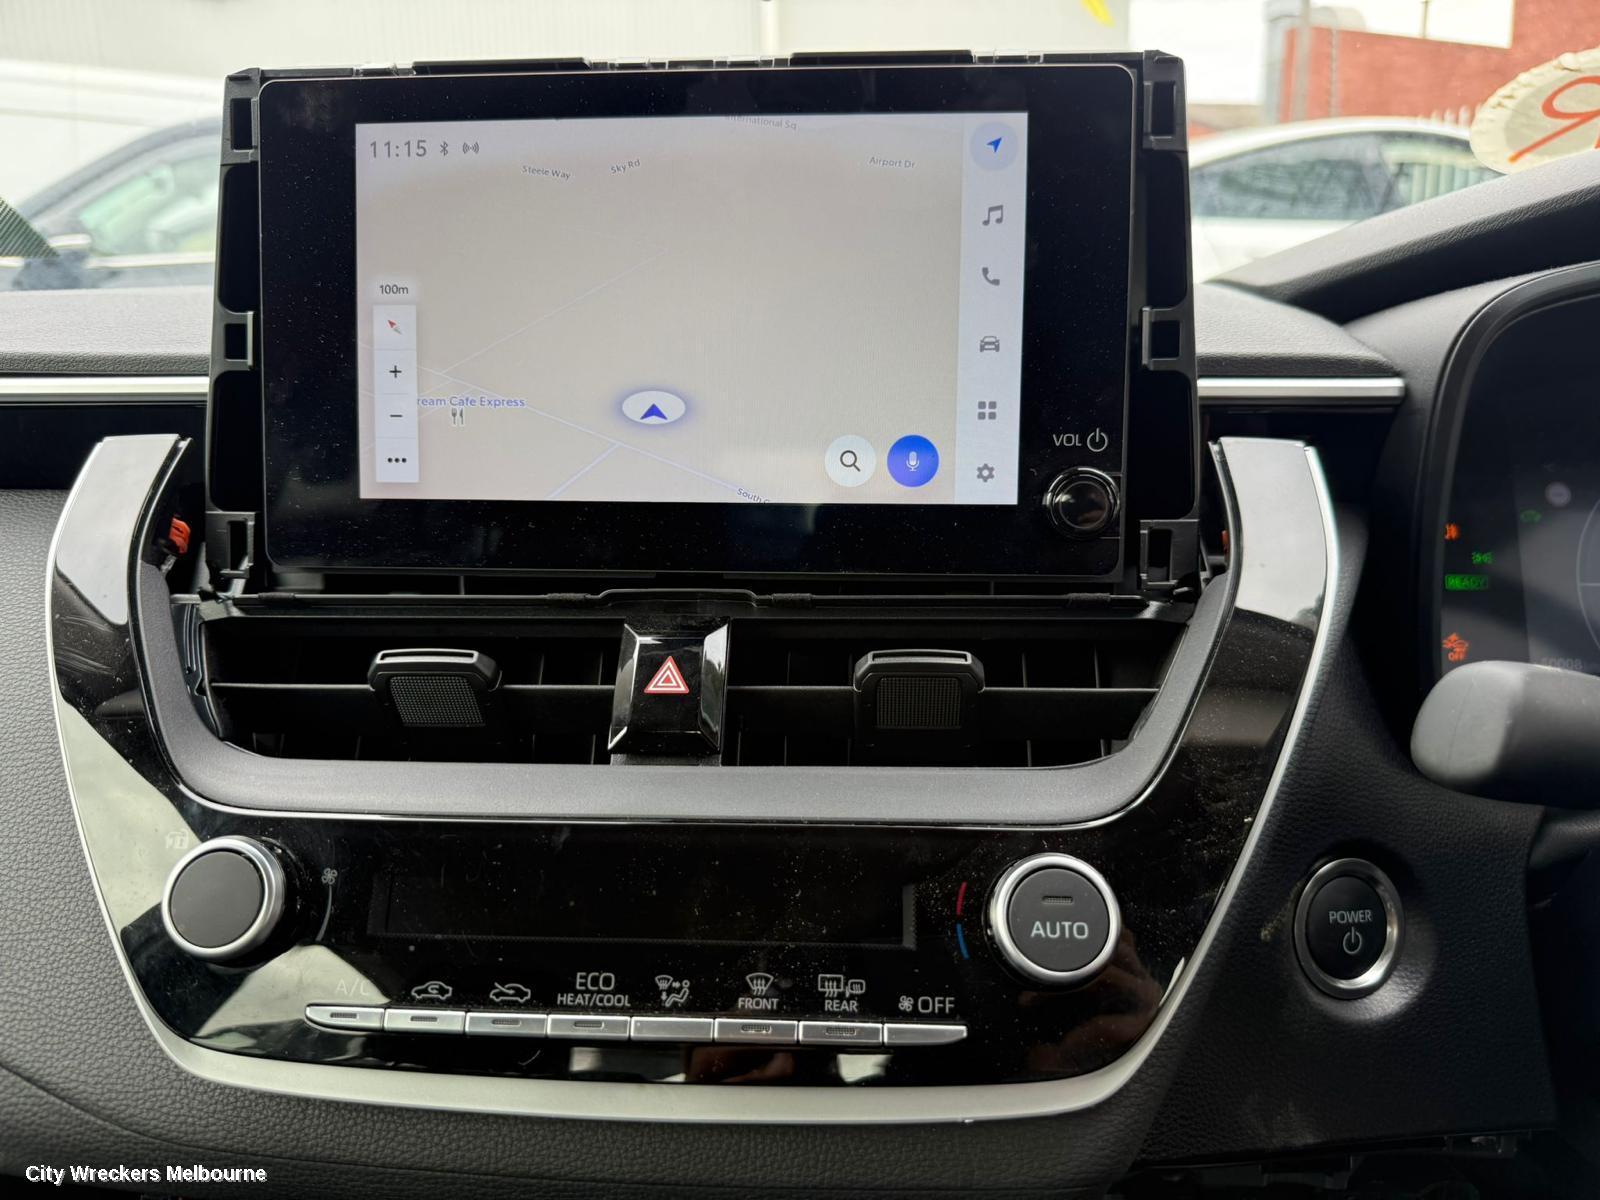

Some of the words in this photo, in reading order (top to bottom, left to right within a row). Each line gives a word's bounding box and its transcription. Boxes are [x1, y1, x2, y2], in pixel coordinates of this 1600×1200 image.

[369, 139, 428, 158] 11:15
[610, 163, 626, 174] Sky
[627, 159, 641, 169] Rd
[869, 156, 902, 168] Airport
[904, 160, 915, 169] Dr
[521, 165, 550, 176] Steele
[551, 169, 571, 180] Way
[379, 284, 409, 295] 100m
[417, 398, 447, 407] ream
[450, 396, 477, 407] Cafe
[479, 396, 526, 408] Express
[1052, 433, 1082, 447] VOL
[1328, 909, 1372, 924] POWER
[1030, 920, 1089, 939] AUTO
[334, 978, 370, 996] A/C
[575, 972, 615, 991] ECO
[557, 993, 630, 1007] HEAT/COOL
[737, 997, 779, 1010] FRONT
[824, 999, 859, 1012] REAR
[917, 996, 955, 1013] OFF
